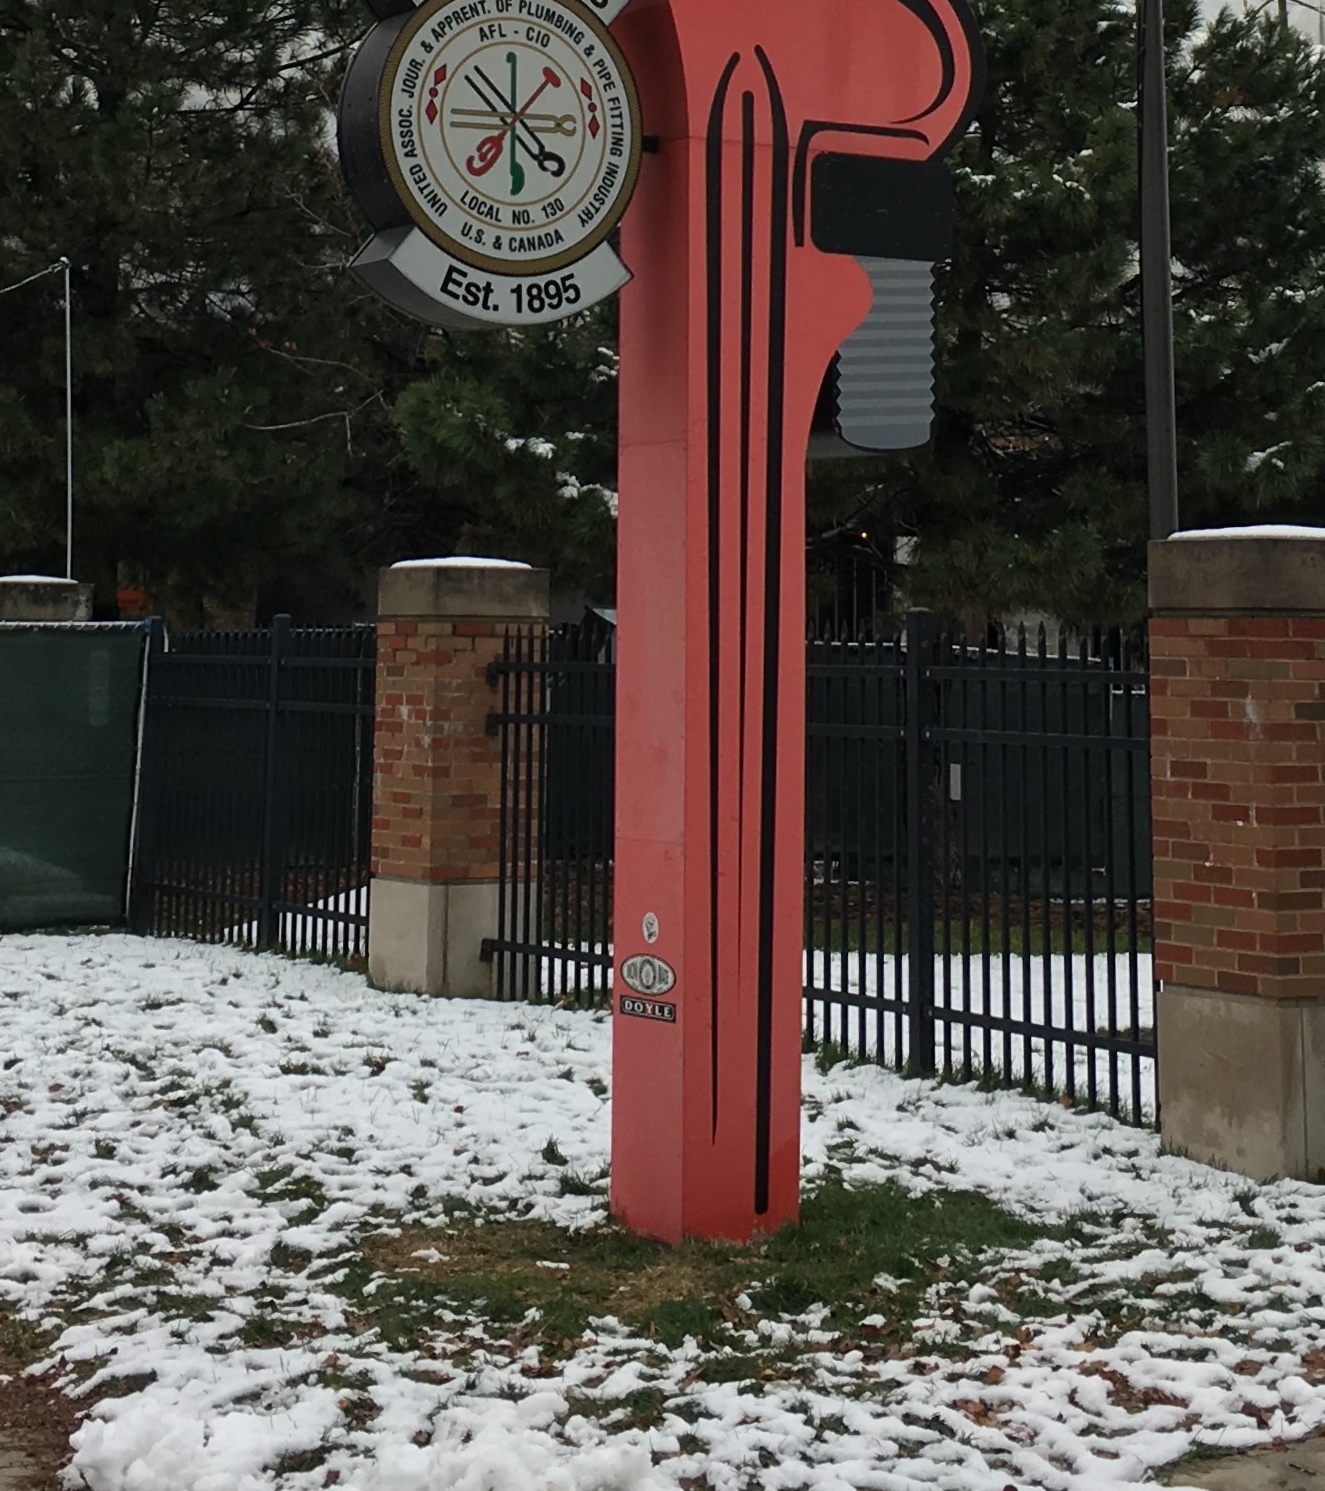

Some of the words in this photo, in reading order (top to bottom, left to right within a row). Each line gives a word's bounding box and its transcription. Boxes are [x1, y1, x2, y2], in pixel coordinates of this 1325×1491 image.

[431, 0, 491, 43] APPRENT.
[478, 23, 508, 42] AFL
[525, 26, 551, 48] CIO
[518, 0, 585, 45] PLUMBING
[420, 39, 434, 54] &
[583, 44, 596, 58] &
[401, 58, 426, 99] JOUR.
[593, 58, 617, 93] PIPE
[398, 104, 419, 159] ASSOC.
[607, 96, 625, 158] FITTING
[409, 163, 449, 218] UNITED
[460, 190, 502, 223] LOCAL
[512, 209, 535, 225] NO.
[541, 197, 565, 219] 130
[577, 161, 620, 228] INDUSTRY
[460, 221, 486, 246] U.S.
[492, 234, 503, 251] &
[509, 228, 565, 253] CANADA
[439, 263, 500, 312] Est.
[510, 272, 581, 314] 1895
[624, 1000, 672, 1018] DOYLE
